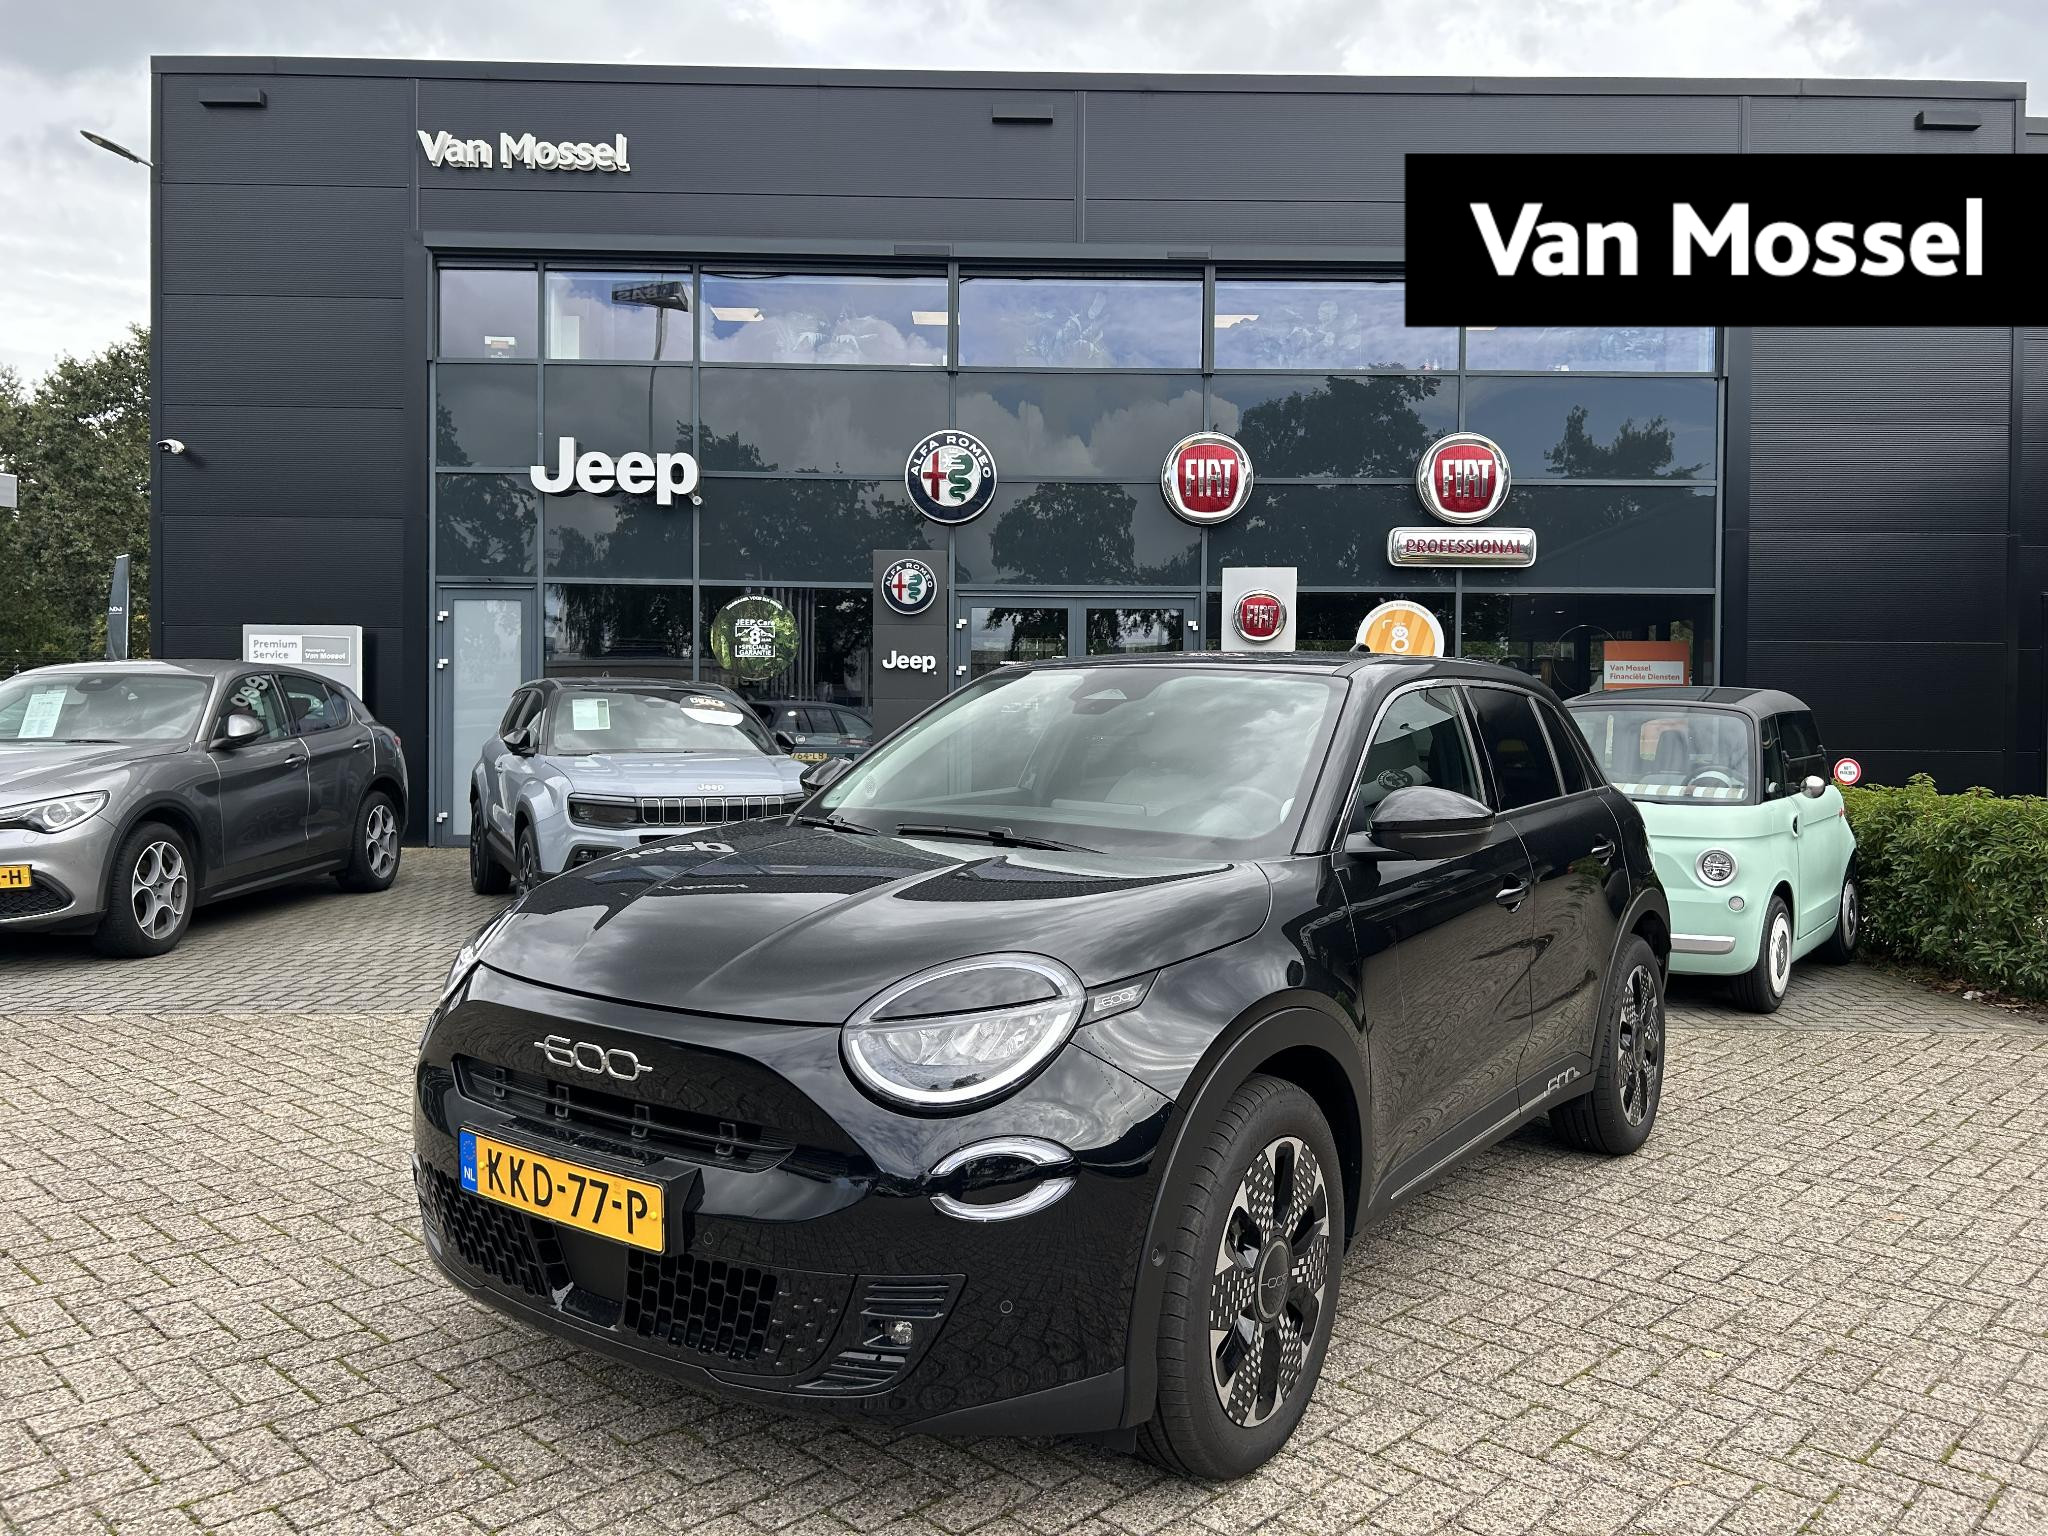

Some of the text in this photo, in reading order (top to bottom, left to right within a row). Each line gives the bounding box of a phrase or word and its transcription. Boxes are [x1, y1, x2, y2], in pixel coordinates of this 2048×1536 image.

[417, 130, 631, 172] Van Mossel
[911, 435, 992, 478] ALFA ROMEO
[530, 436, 698, 505] Jeep
[1185, 458, 1235, 497] FIAT
[1442, 459, 1493, 498] FIAT
[1405, 539, 1523, 554] PROFESSIONAL
[885, 562, 933, 588] ALFA ROMEO
[1246, 604, 1277, 629] FIAT
[253, 640, 298, 649] Premium
[749, 629, 760, 645] 8
[253, 650, 289, 659] Service
[305, 652, 346, 660] Van Mossel
[882, 650, 936, 673] Jeep
[1610, 664, 1651, 672] Van Mossel
[1610, 672, 1680, 681] Financiële Diensten
[696, 783, 725, 791] Jeep
[1099, 992, 1133, 1007] 600
[533, 1034, 653, 1081] 600
[464, 1165, 476, 1182] NL
[487, 1148, 648, 1234] KKD-77-P
